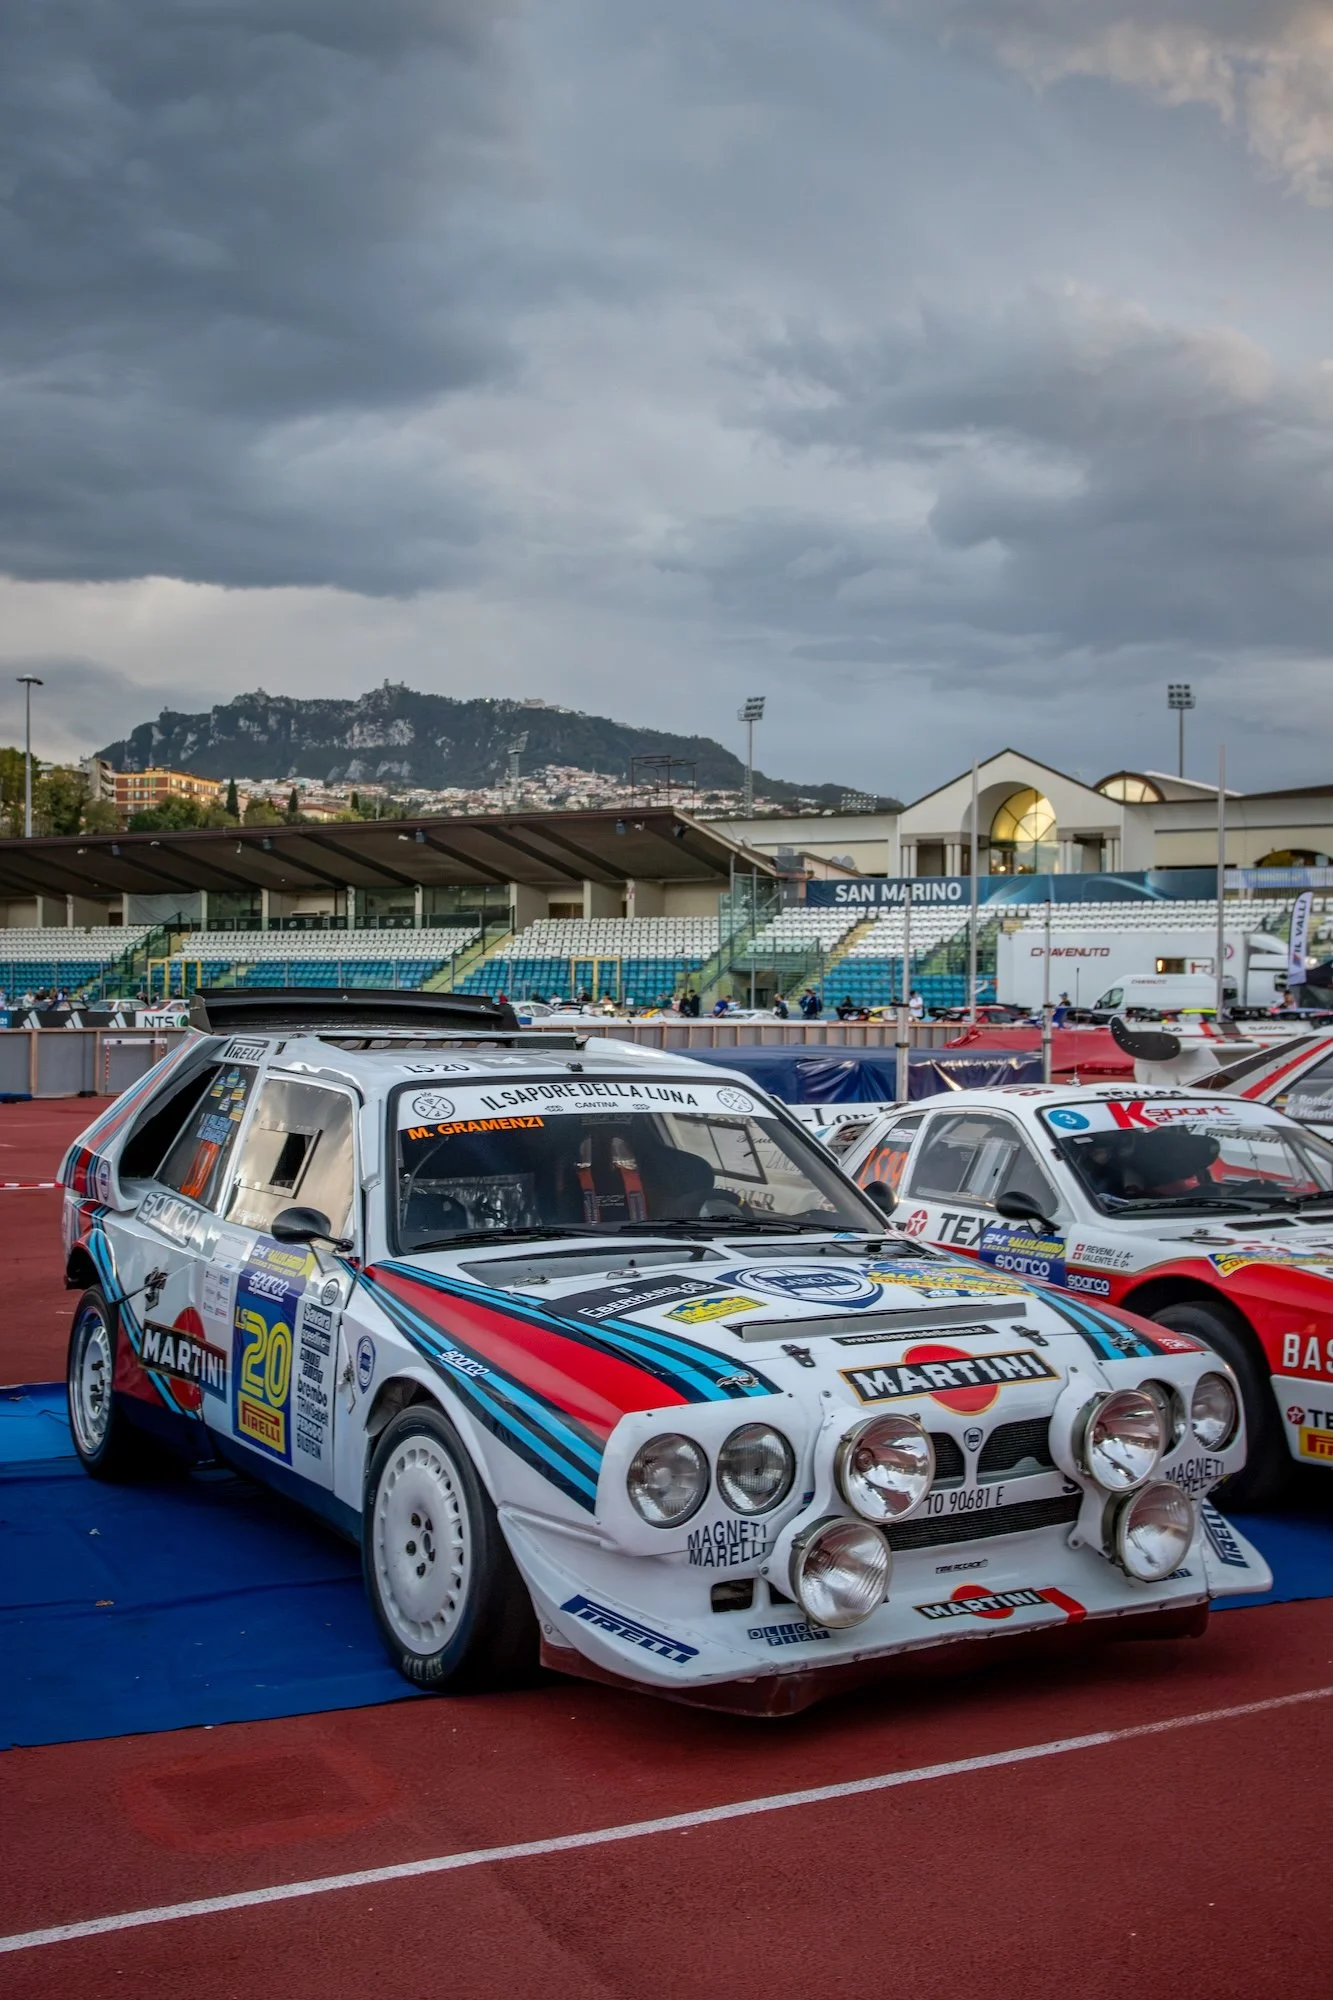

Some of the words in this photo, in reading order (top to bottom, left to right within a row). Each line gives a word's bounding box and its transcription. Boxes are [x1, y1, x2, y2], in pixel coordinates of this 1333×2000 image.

[835, 884, 875, 903] SAN
[881, 882, 962, 902] MARINO
[224, 1038, 269, 1062] PIRELLI
[405, 1064, 434, 1074] LS
[436, 1062, 470, 1072] 20
[507, 1084, 580, 1105] SAPORE
[580, 1083, 642, 1099] DELLA
[648, 1087, 699, 1107] LUNA
[575, 1101, 619, 1109] CANTINA
[407, 1126, 434, 1141] M.
[439, 1116, 545, 1136] GRAMENZI
[1059, 1113, 1077, 1124] 3
[141, 1193, 200, 1238] sparco
[995, 1254, 1050, 1279] sparco
[248, 1271, 290, 1300] sparco
[773, 1274, 846, 1287] LANCIA
[1067, 1274, 1110, 1295] sparco
[577, 1286, 681, 1318] EBERHARD
[143, 1333, 224, 1391] MARTINI
[242, 1310, 292, 1408] 20
[439, 1350, 490, 1376] sparco
[852, 1354, 1047, 1397] MARTINI
[242, 1400, 281, 1444] PIRELLI
[1165, 1458, 1224, 1483] MAGNETI
[923, 1493, 943, 1515] TO
[950, 1487, 990, 1513] 90681
[996, 1486, 1005, 1506] E
[688, 1520, 766, 1550] MAGNETI
[1202, 1504, 1250, 1568] PIRELLI
[689, 1540, 766, 1567] MARELLI
[921, 1591, 1042, 1618] MARTINI
[560, 1595, 700, 1664] PIRELLI
[748, 1624, 811, 1640] OLIO
[768, 1630, 830, 1647] FIAT
